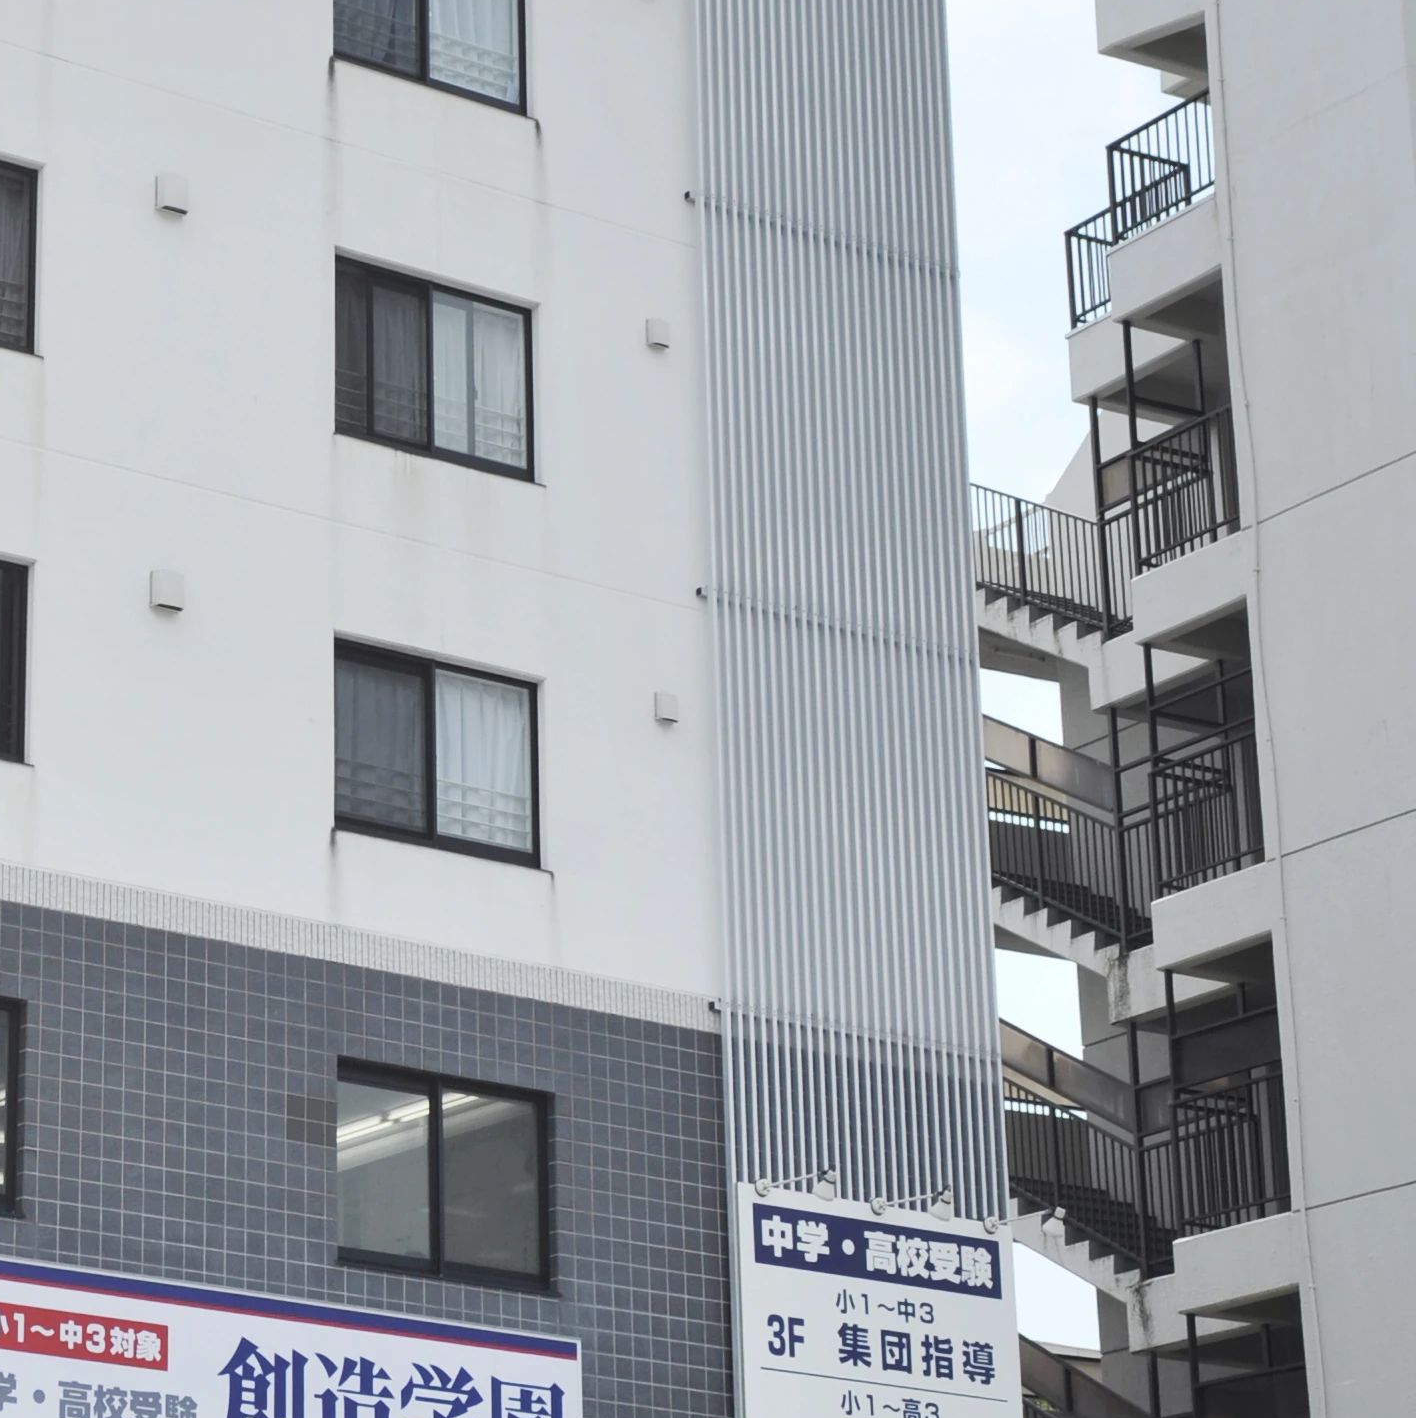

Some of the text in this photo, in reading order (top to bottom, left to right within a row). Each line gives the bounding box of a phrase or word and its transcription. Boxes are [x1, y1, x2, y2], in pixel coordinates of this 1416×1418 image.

[760, 1215, 994, 1290] 中学・高校受験
[767, 1314, 996, 1385] 3F 集団指導
